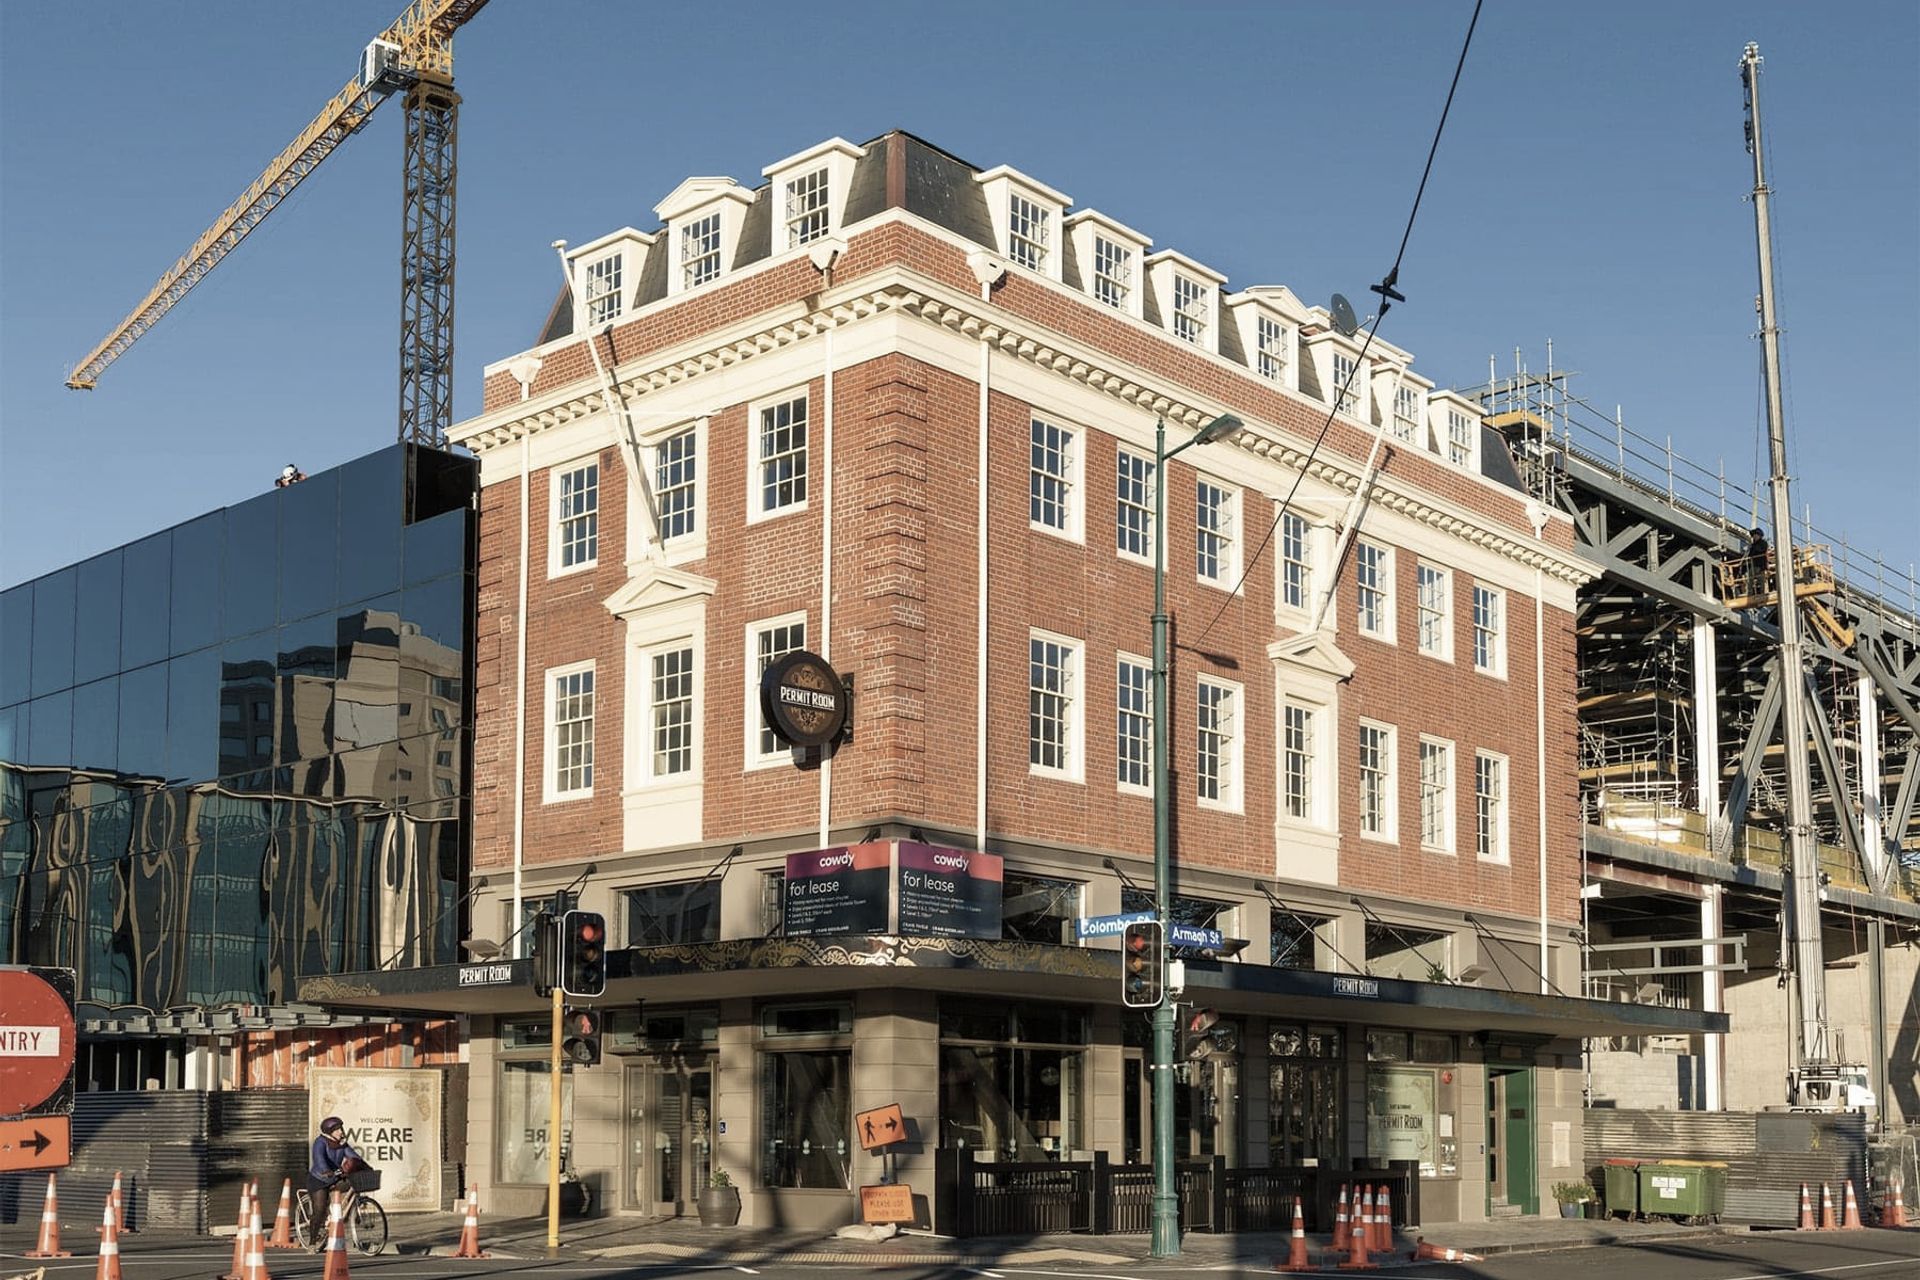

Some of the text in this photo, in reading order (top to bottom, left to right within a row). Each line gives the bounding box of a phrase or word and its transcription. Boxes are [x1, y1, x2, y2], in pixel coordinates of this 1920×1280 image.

[811, 692, 835, 709] ROOM
[820, 851, 855, 868] cowdy
[933, 854, 969, 871] cowdy
[789, 880, 840, 897] for lease
[903, 871, 955, 893] for lease
[1172, 926, 1220, 946] Armagh St
[460, 965, 512, 984] PERMIT ROOM
[1359, 980, 1379, 996] ROOM
[1404, 1114, 1423, 1129] ROOM
[345, 1127, 413, 1143] WE ARE
